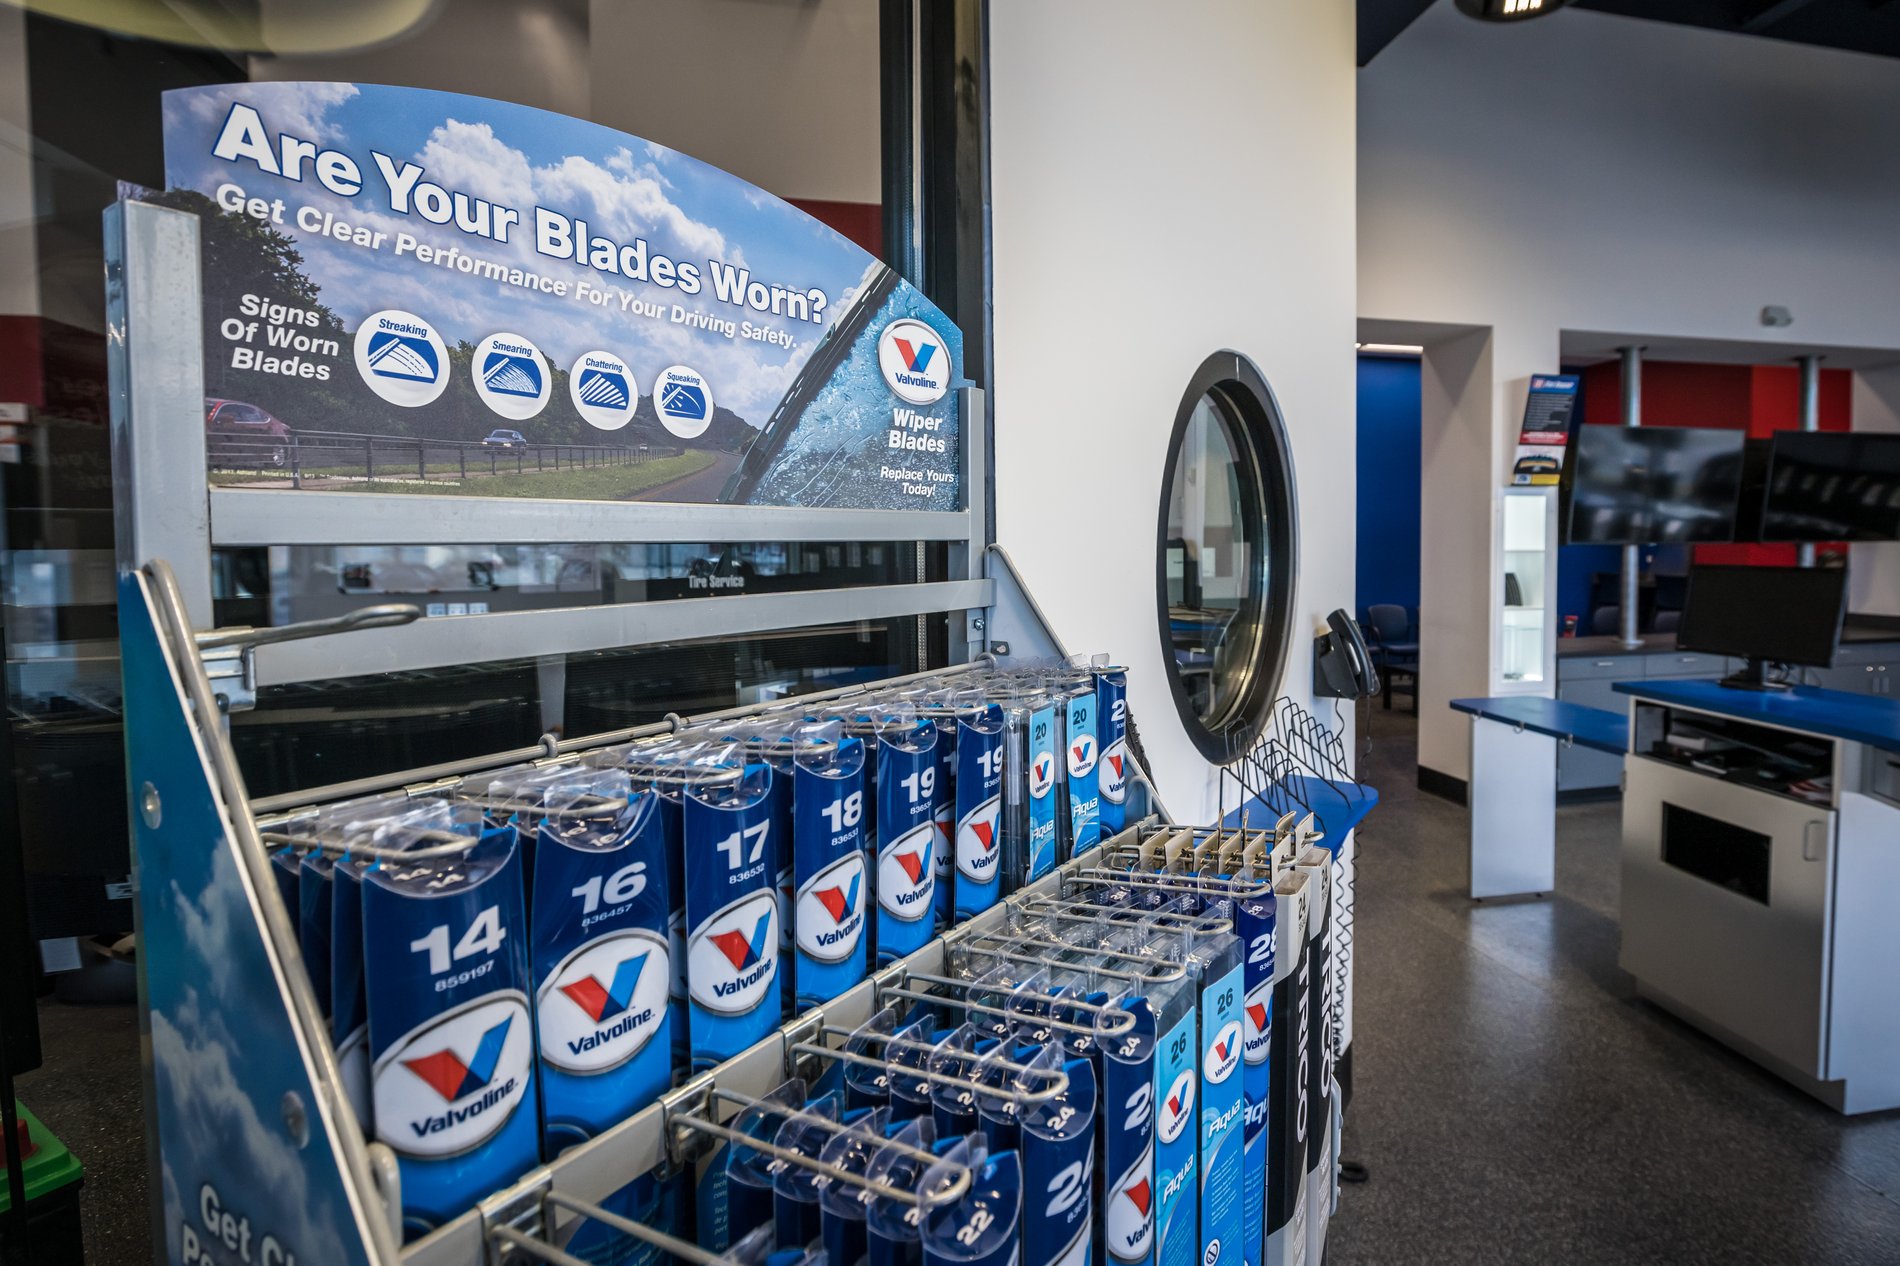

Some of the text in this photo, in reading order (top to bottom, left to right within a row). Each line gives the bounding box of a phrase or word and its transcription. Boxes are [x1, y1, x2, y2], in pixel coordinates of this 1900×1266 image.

[212, 101, 828, 325] Are Your Blades Worn?
[216, 183, 286, 225] Get
[297, 206, 387, 250] Clear
[576, 281, 613, 308] For
[617, 296, 666, 320] Your
[671, 305, 735, 339] Driving
[740, 322, 797, 349] Safety.
[239, 293, 320, 328] Signs
[220, 317, 340, 357] Of Worn
[378, 318, 428, 338] Streaking
[231, 347, 331, 381] Blades
[492, 340, 533, 358] Smearing
[585, 356, 623, 373] Chattering
[667, 371, 701, 386] Squeaking
[895, 371, 940, 390] Valvoline
[893, 408, 942, 433] Wiper
[888, 430, 946, 454] Blades
[880, 465, 955, 484] Replace Yours
[901, 481, 936, 497] Today!
[688, 574, 745, 589] Tire Service
[1073, 708, 1087, 725] 20
[1111, 698, 1126, 722] 2
[1035, 723, 1047, 741] 20
[977, 745, 1003, 778] 19
[901, 766, 935, 803] 19
[822, 791, 862, 833] 18
[1073, 797, 1098, 817] Aqua
[717, 818, 770, 870] 17
[1032, 819, 1054, 841] Aqua
[572, 861, 647, 914] 16
[581, 904, 633, 928] 836457
[815, 914, 862, 947] Valvoline
[411, 904, 506, 975] 14
[434, 960, 495, 992] 859197
[713, 957, 772, 998] Valvoline
[1217, 987, 1234, 1015] 26
[567, 1008, 652, 1056] Valvoline
[1119, 1037, 1141, 1057] 24
[1170, 1031, 1187, 1064] 26
[1297, 950, 1309, 1142] TRICO
[1214, 1056, 1237, 1078] Valvoline
[410, 1078, 517, 1138] Valvoline
[1047, 1106, 1076, 1131] 24
[1124, 1081, 1153, 1131] 2
[1167, 1106, 1190, 1136] Valvoline
[1208, 1098, 1241, 1139] Aqua
[1244, 1097, 1267, 1127] Aqu
[1163, 1153, 1194, 1206] Aqua
[200, 1184, 251, 1263] Get
[957, 1210, 994, 1247] 22
